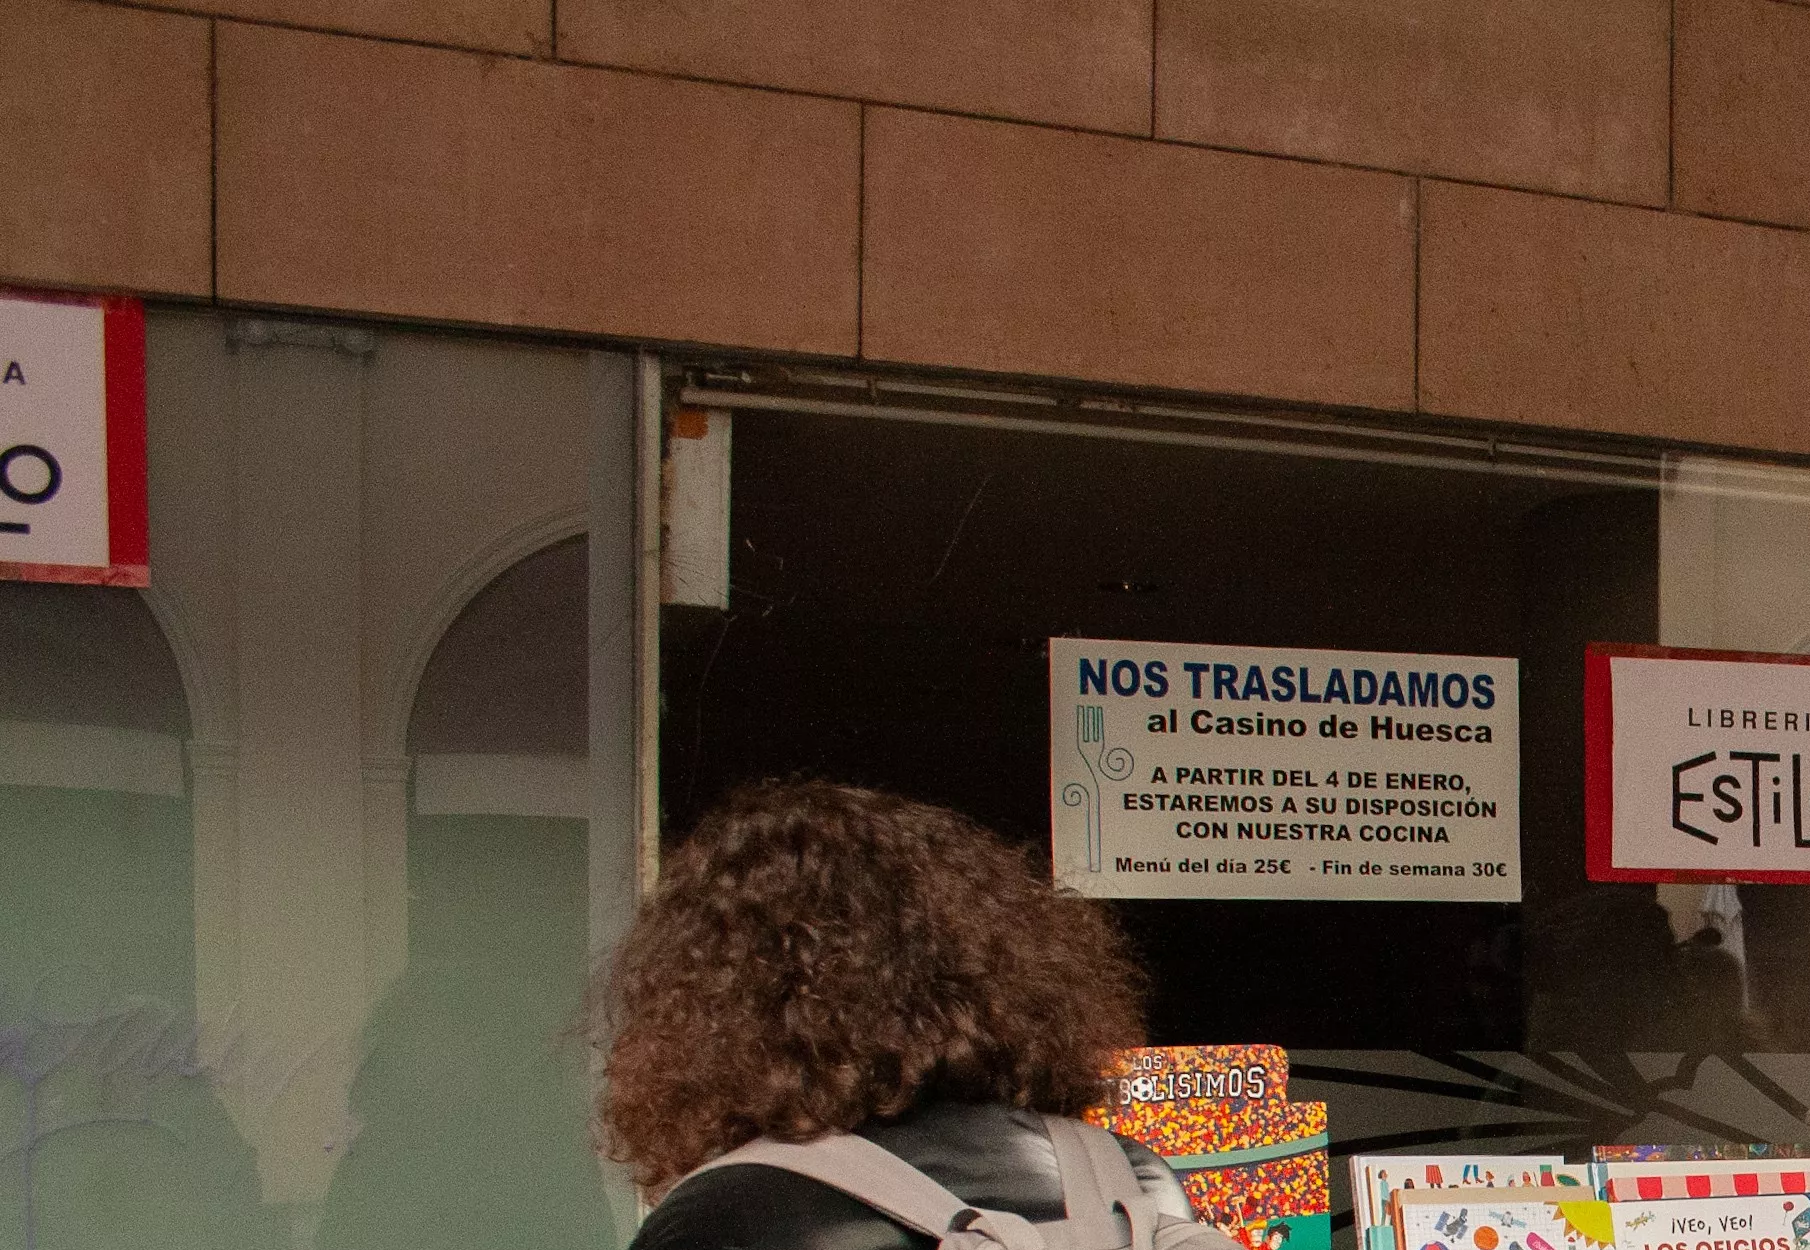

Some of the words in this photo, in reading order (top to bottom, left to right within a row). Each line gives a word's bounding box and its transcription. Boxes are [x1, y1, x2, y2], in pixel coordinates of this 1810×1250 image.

[1079, 657, 1169, 698] NOS
[1183, 662, 1497, 711] TRASLADAMOS
[1147, 710, 1178, 735] al
[1190, 709, 1308, 739] Casino
[1318, 714, 1359, 740] de
[1370, 715, 1494, 745] Huesca
[1150, 767, 1169, 785] A
[1175, 767, 1265, 788] PARTIR
[1272, 769, 1319, 789] DEL
[1325, 770, 1340, 789] 4
[1347, 771, 1378, 790] DE
[1385, 771, 1473, 796] ENERO,
[1123, 794, 1274, 815] ESTAREMOS
[1281, 796, 1299, 815] A
[1306, 797, 1338, 816] SU
[1345, 793, 1498, 819] DISPOSICIÓN
[1175, 820, 1229, 841] CON
[1236, 822, 1352, 843] NUESTRA
[1358, 824, 1451, 845] COCINA
[1115, 856, 1172, 875] Menú
[1178, 858, 1210, 875] del
[1253, 858, 1292, 876] 25€
[1321, 859, 1353, 878] Fin
[1359, 859, 1382, 878] de
[1388, 864, 1467, 878] semana
[1471, 861, 1509, 878] 30€
[1132, 1054, 1163, 1073] LOS
[1718, 1214, 1753, 1232] VEO!
